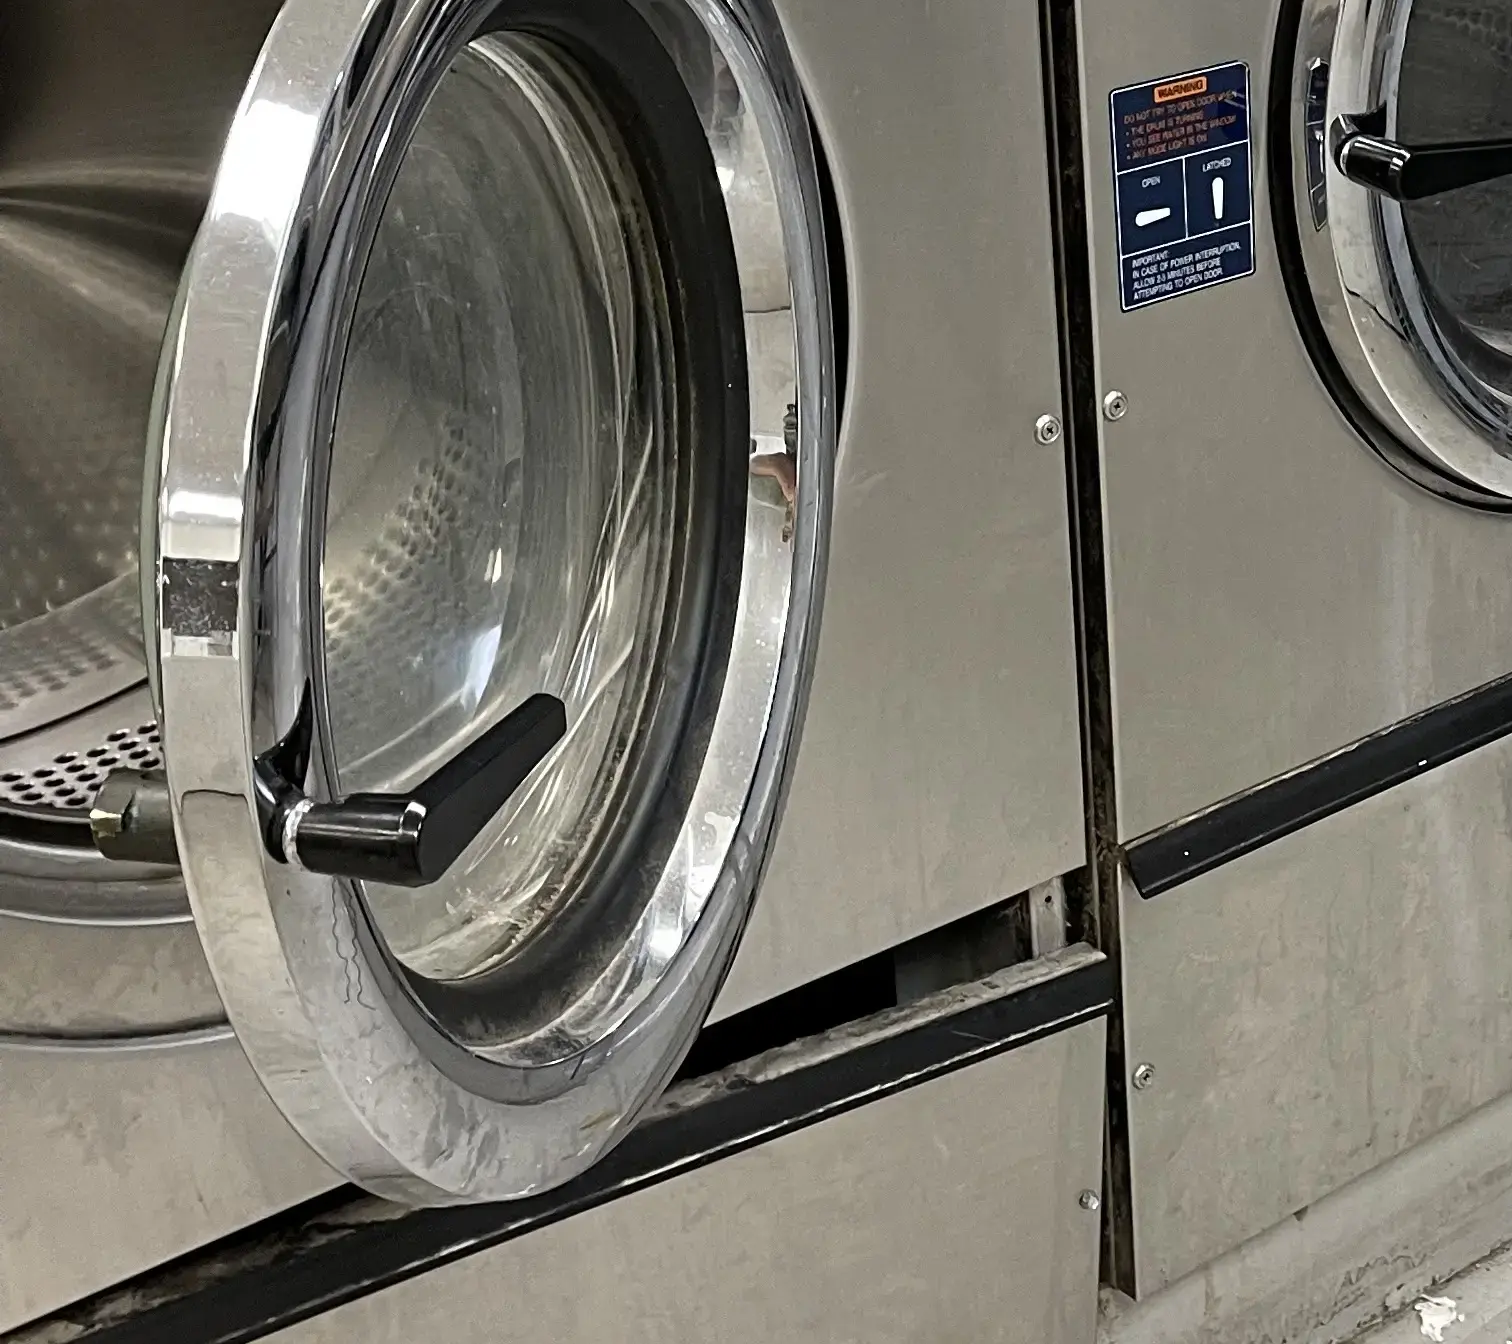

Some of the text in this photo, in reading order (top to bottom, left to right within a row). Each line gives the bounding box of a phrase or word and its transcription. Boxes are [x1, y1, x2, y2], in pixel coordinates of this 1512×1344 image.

[1157, 79, 1204, 99] WARNING
[1124, 114, 1135, 125] DO
[1136, 110, 1150, 121] NOT
[1196, 93, 1217, 107] DOOR
[1202, 157, 1232, 172] LATCHED
[1141, 176, 1161, 188] OPEN
[1132, 269, 1140, 279] IN
[1141, 264, 1158, 277] CASE
[1160, 260, 1169, 271] OF
[1170, 254, 1194, 269] POWER
[1132, 276, 1156, 290] ALLOW
[1167, 264, 1195, 280] MINUTES
[1196, 257, 1221, 272] BEFORE
[1133, 282, 1174, 300] ATTEMPTING
[1174, 278, 1184, 288] TO
[1184, 273, 1203, 286] OPEN
